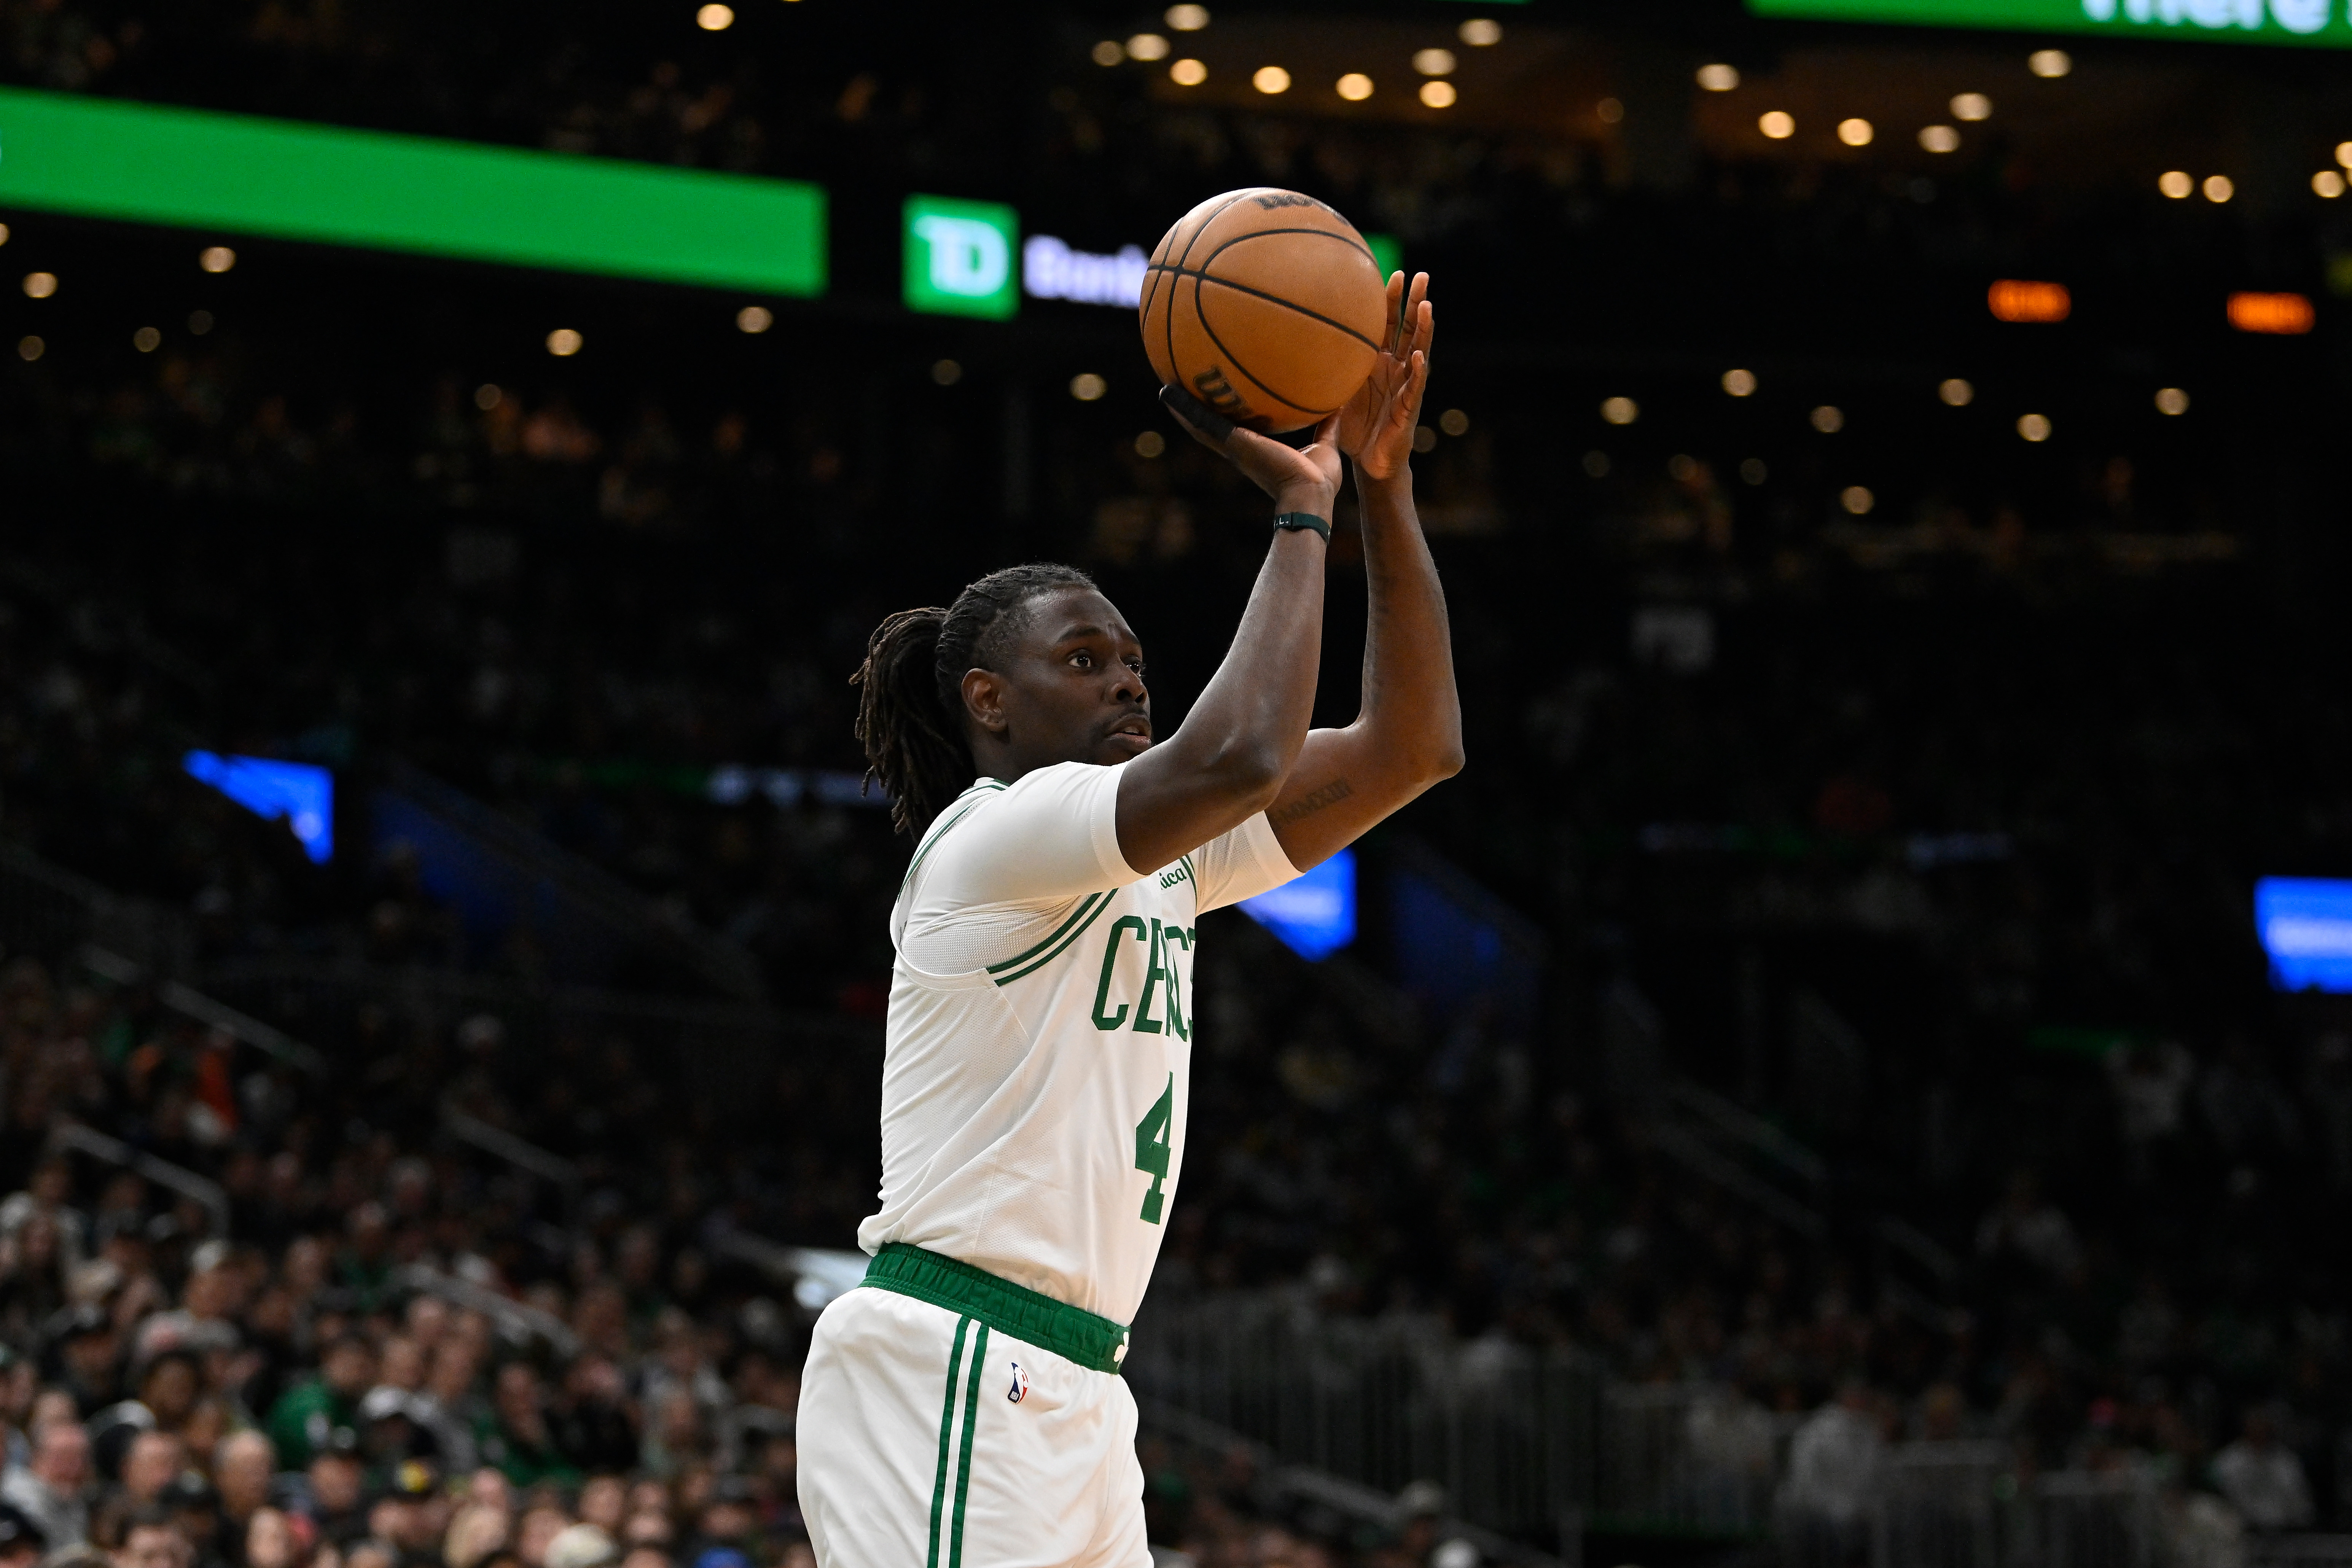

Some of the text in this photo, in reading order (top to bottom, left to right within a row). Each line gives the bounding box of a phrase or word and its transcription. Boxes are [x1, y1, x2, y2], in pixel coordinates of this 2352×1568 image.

[912, 214, 1009, 298] TD
[1159, 868, 1187, 890] ica
[1135, 1070, 1173, 1225] 4
[1010, 1391, 1019, 1401] NBA
